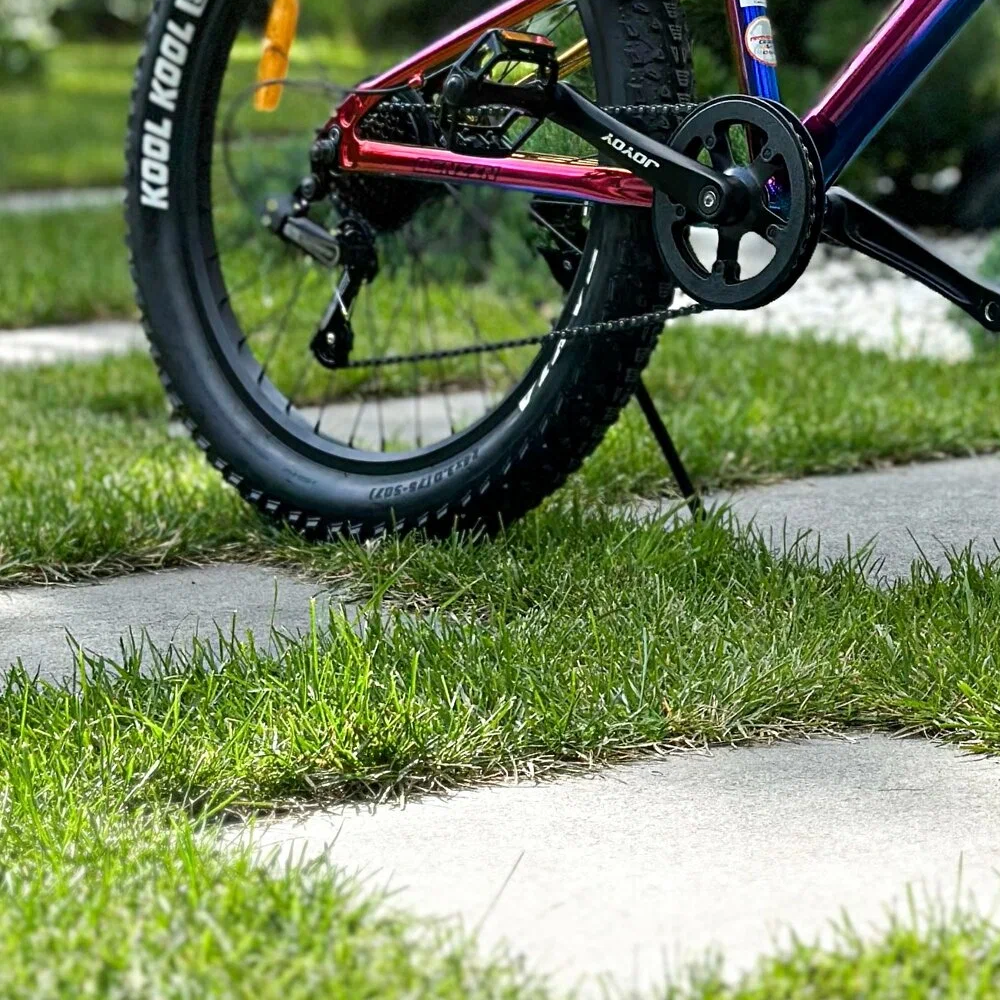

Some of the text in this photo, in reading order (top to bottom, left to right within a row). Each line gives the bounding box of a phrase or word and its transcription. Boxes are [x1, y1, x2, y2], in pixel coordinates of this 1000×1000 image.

[141, 20, 197, 210] KOOL KOOL
[600, 132, 660, 168] JOYOY
